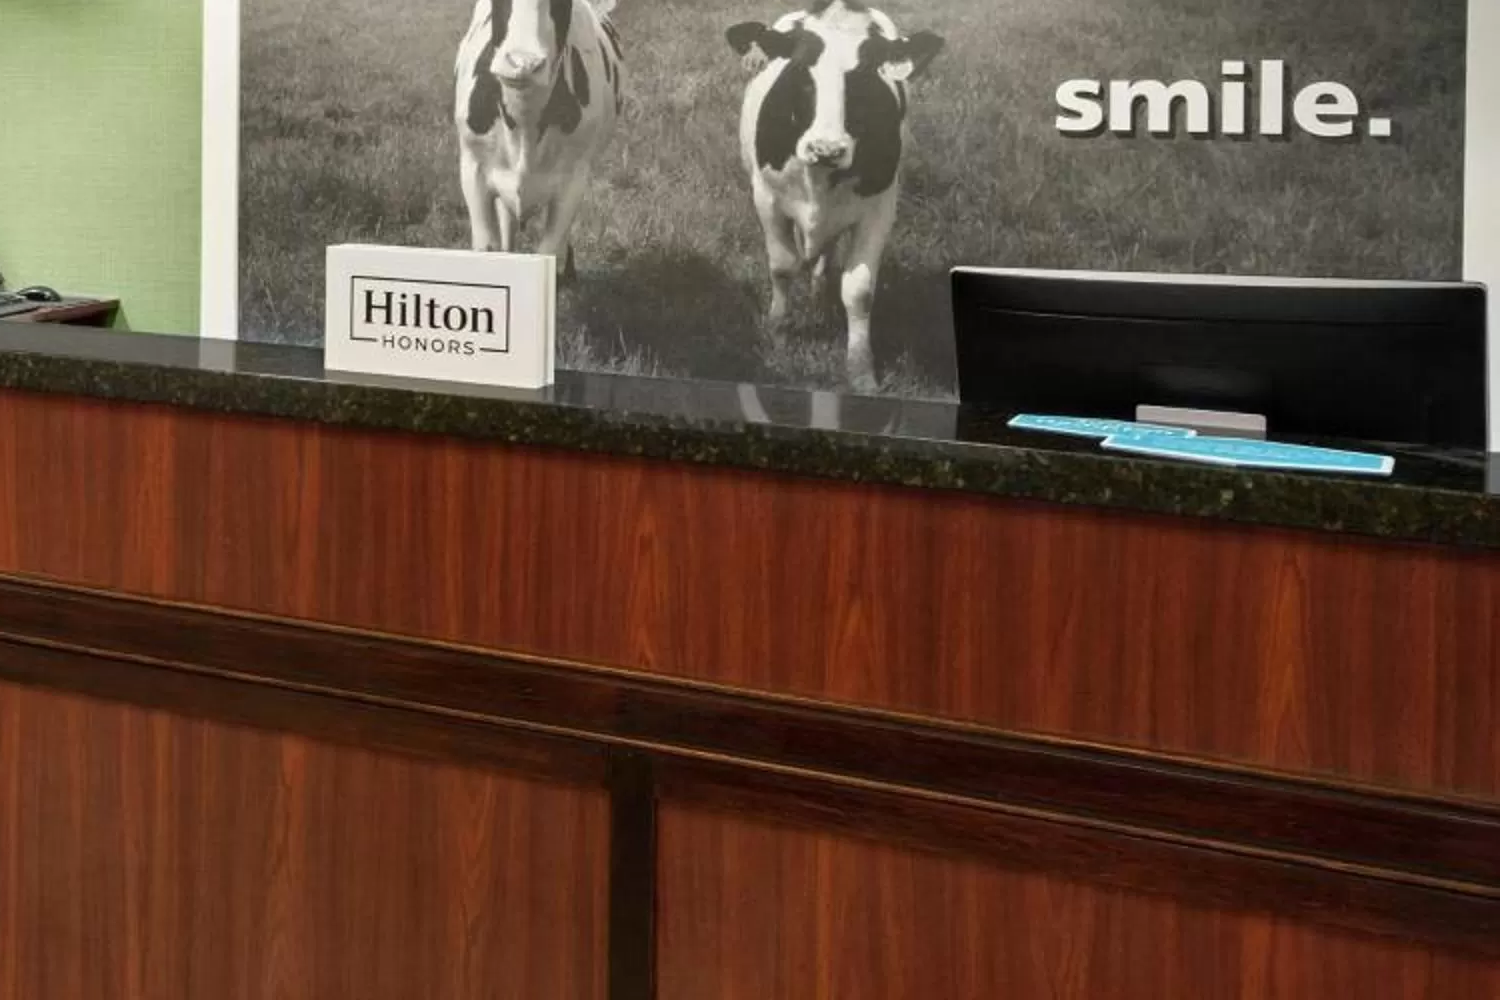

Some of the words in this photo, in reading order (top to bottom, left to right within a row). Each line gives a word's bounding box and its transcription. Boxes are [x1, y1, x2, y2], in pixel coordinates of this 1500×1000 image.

[1055, 59, 1392, 137] smile.
[364, 289, 496, 333] Hilton
[382, 335, 476, 356] HONORS
